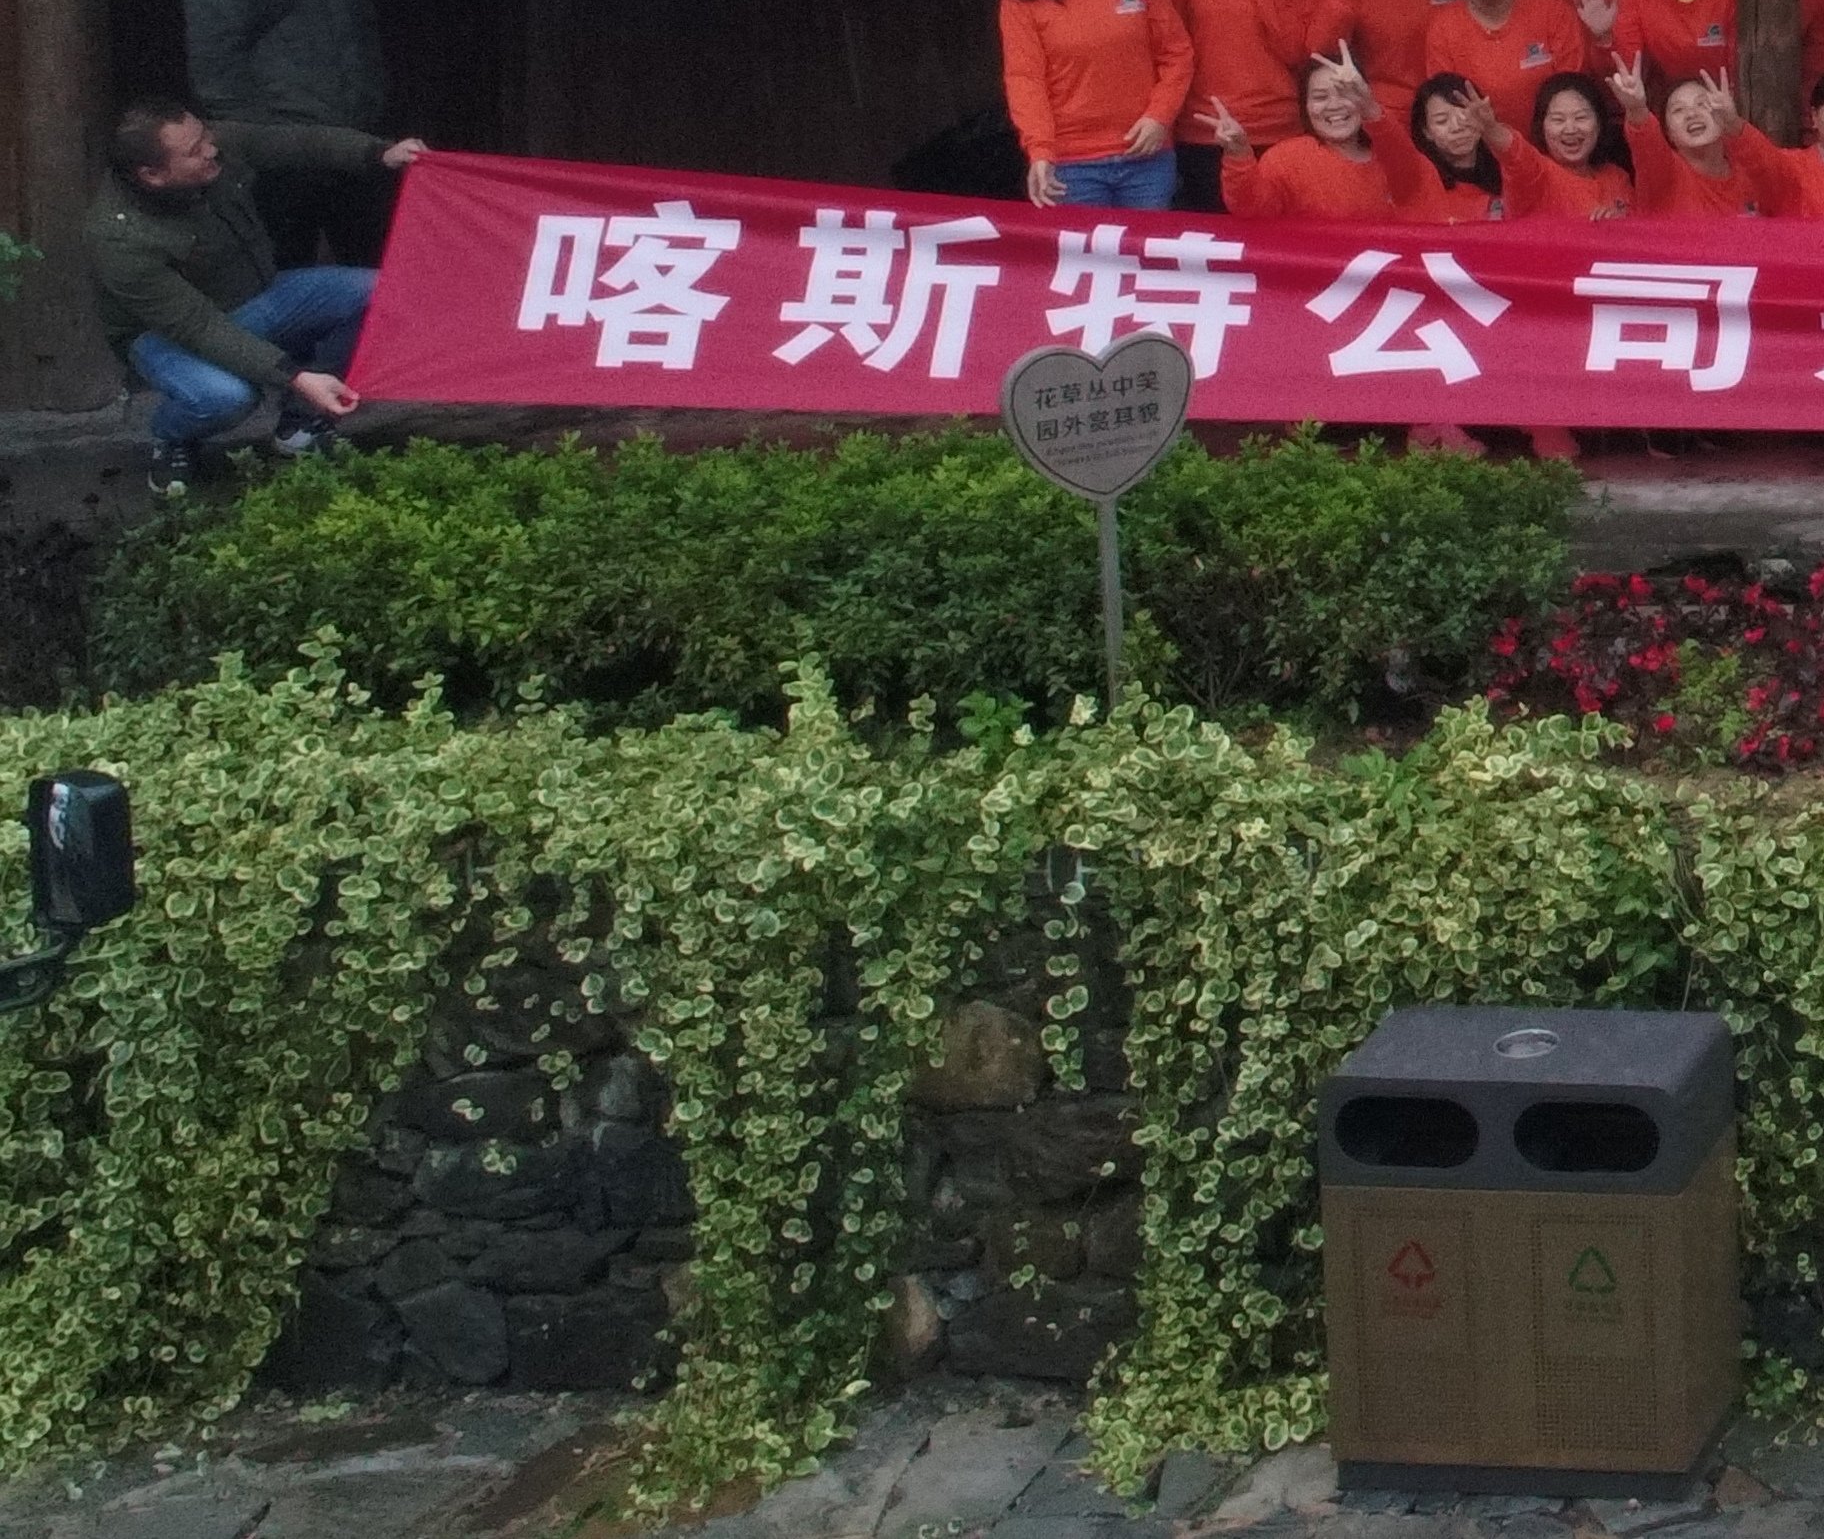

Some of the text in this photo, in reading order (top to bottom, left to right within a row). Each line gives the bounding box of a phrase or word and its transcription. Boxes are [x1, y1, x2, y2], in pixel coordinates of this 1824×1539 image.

[1034, 369, 1161, 412] 花草丛中笑
